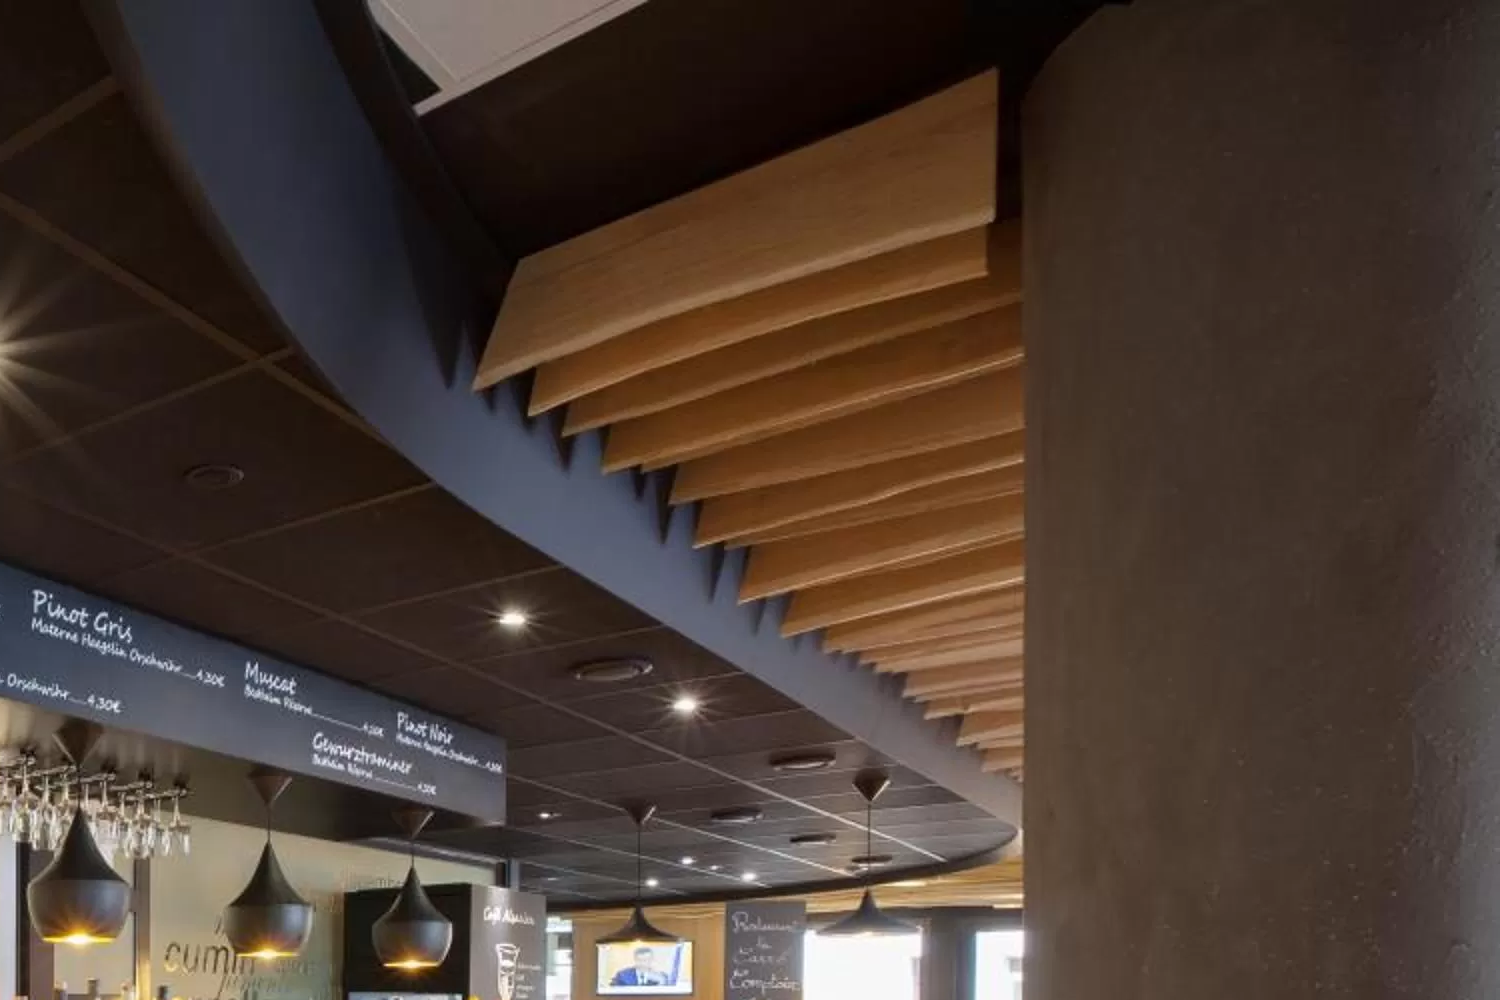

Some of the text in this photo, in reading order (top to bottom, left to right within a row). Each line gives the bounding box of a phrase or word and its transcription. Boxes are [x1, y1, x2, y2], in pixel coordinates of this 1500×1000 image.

[32, 588, 133, 644] Pinot Gris
[243, 660, 298, 696] Muscat
